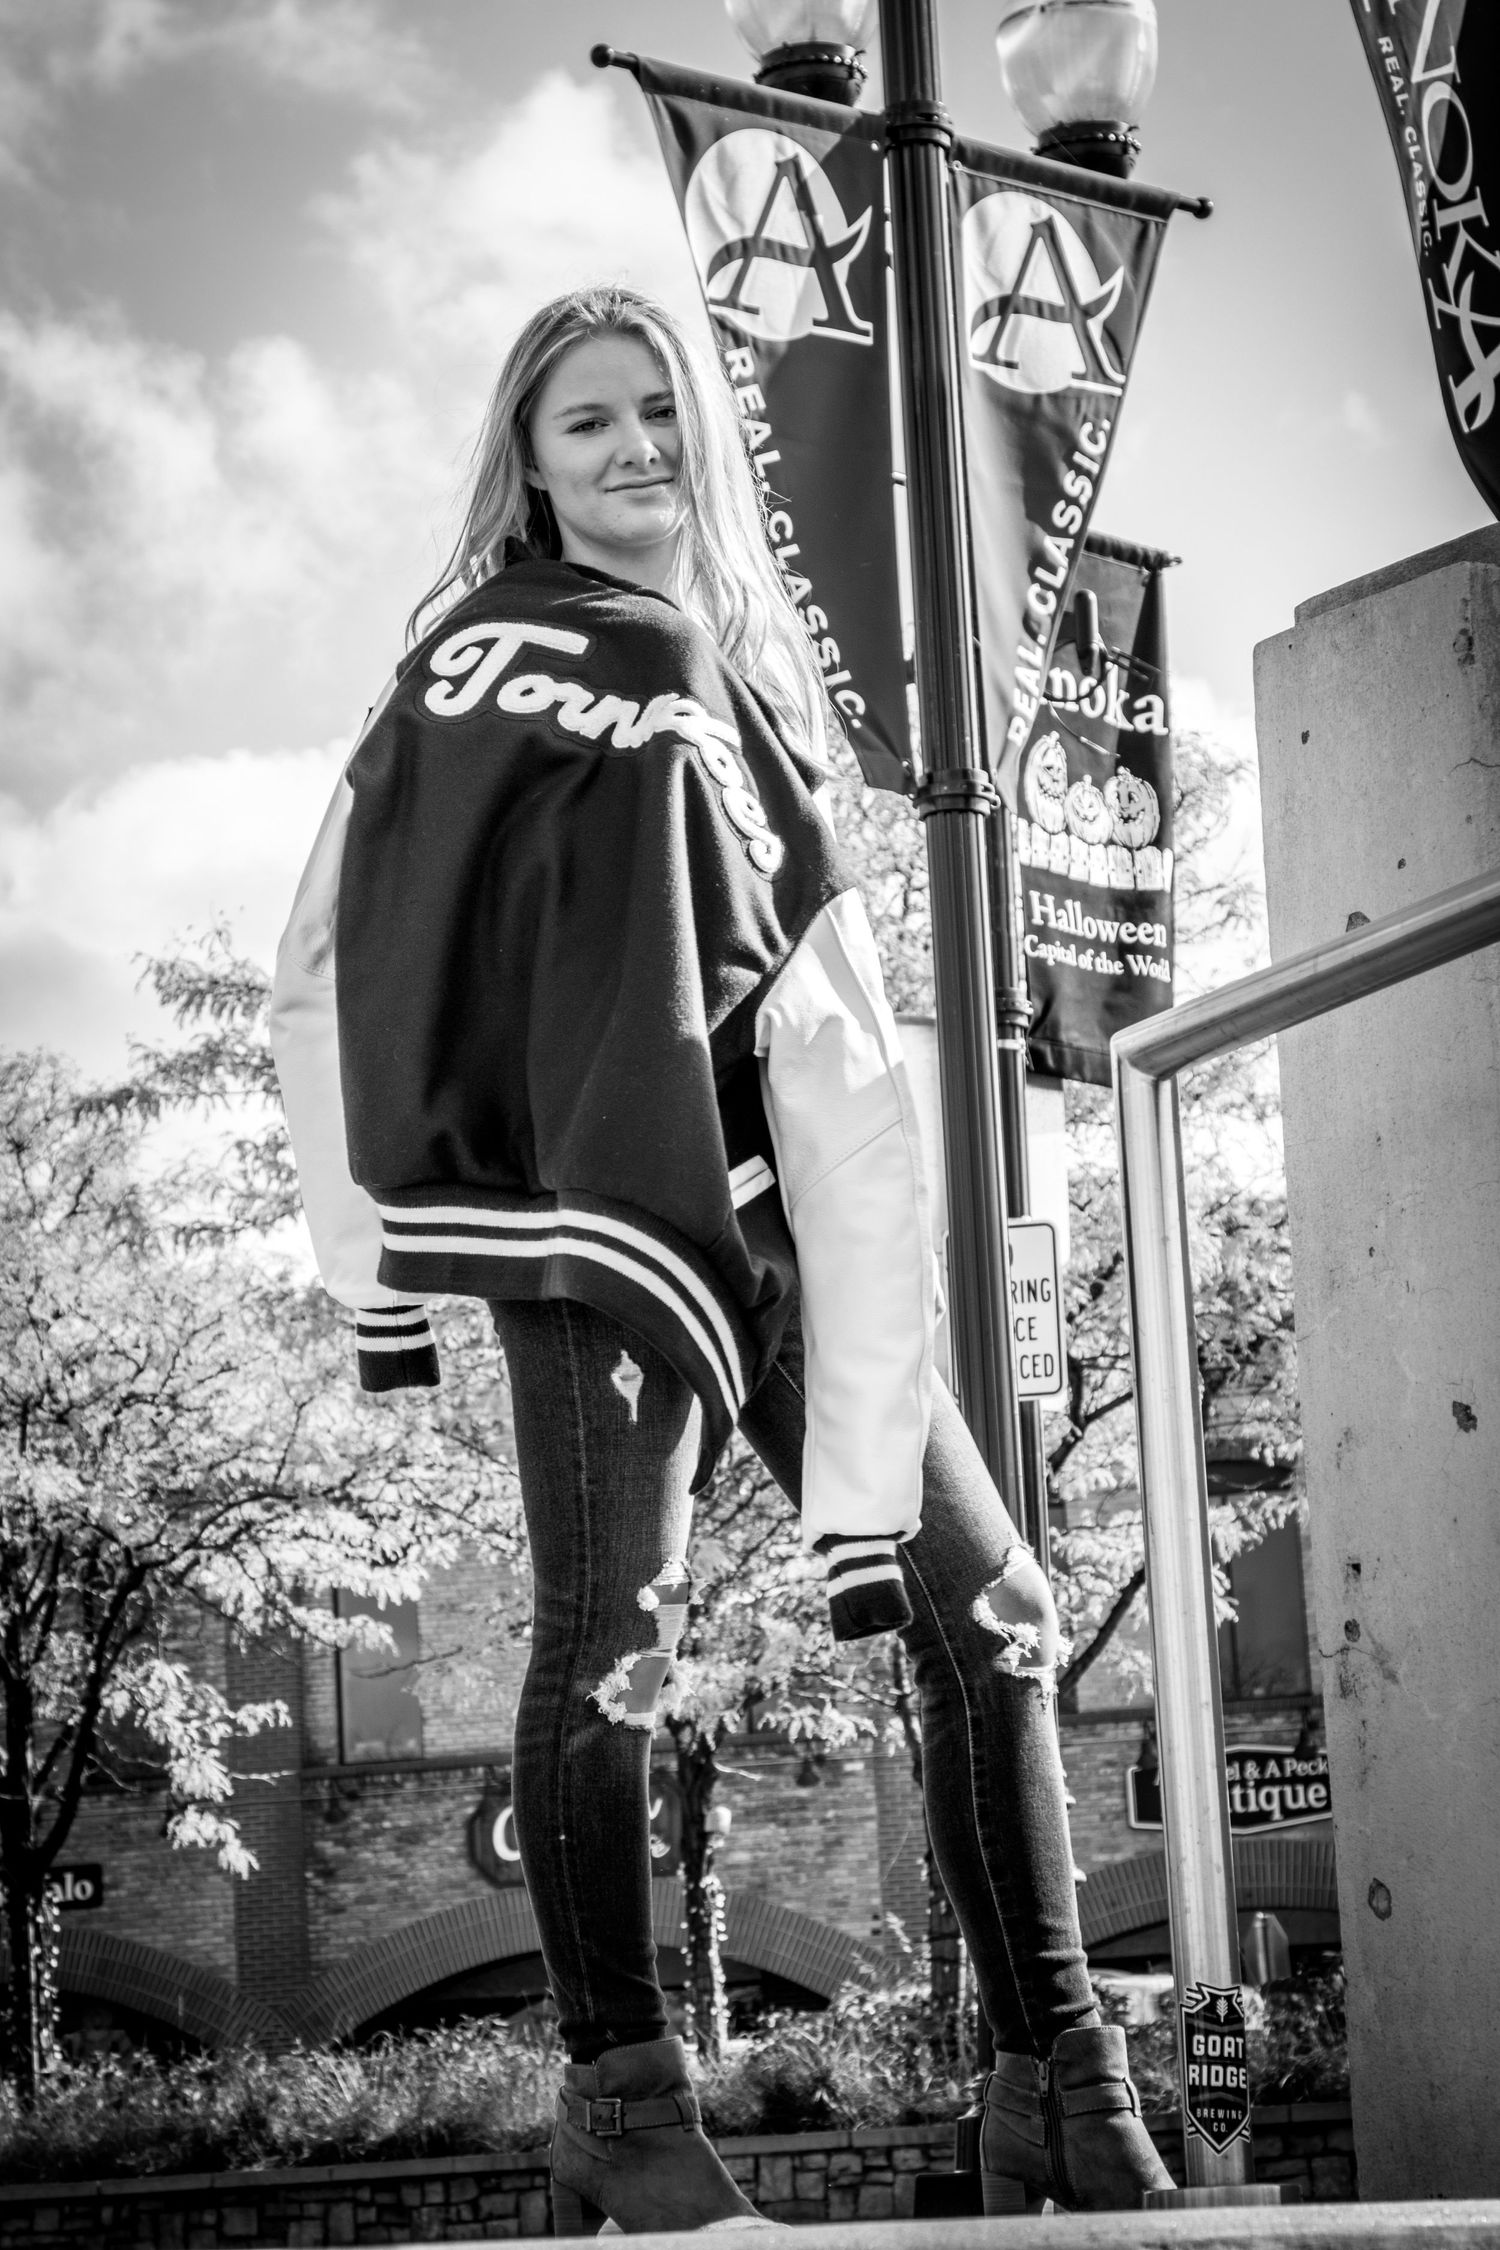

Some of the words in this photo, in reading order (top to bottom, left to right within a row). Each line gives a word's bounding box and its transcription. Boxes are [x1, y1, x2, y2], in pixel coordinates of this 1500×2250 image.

[1378, 36, 1409, 115] REAL.
[1404, 125, 1433, 257] CLASSIC.
[1027, 418, 1112, 617] CLASSIC.
[1039, 660, 1170, 736] noka
[1028, 889, 1168, 948] Halloween
[1024, 934, 1077, 967] Capital
[1077, 947, 1095, 972] of
[1094, 950, 1125, 975] the
[1243, 1759, 1261, 1781] &
[1263, 1758, 1282, 1779] A
[1283, 1757, 1329, 1777] Peck
[1229, 1781, 1328, 1821] tique
[1192, 2034, 1244, 2059] GOAT
[1188, 2064, 1248, 2089] RIDGE
[1196, 2107, 1243, 2121] BREWING
[1213, 2121, 1229, 2133] CO.
